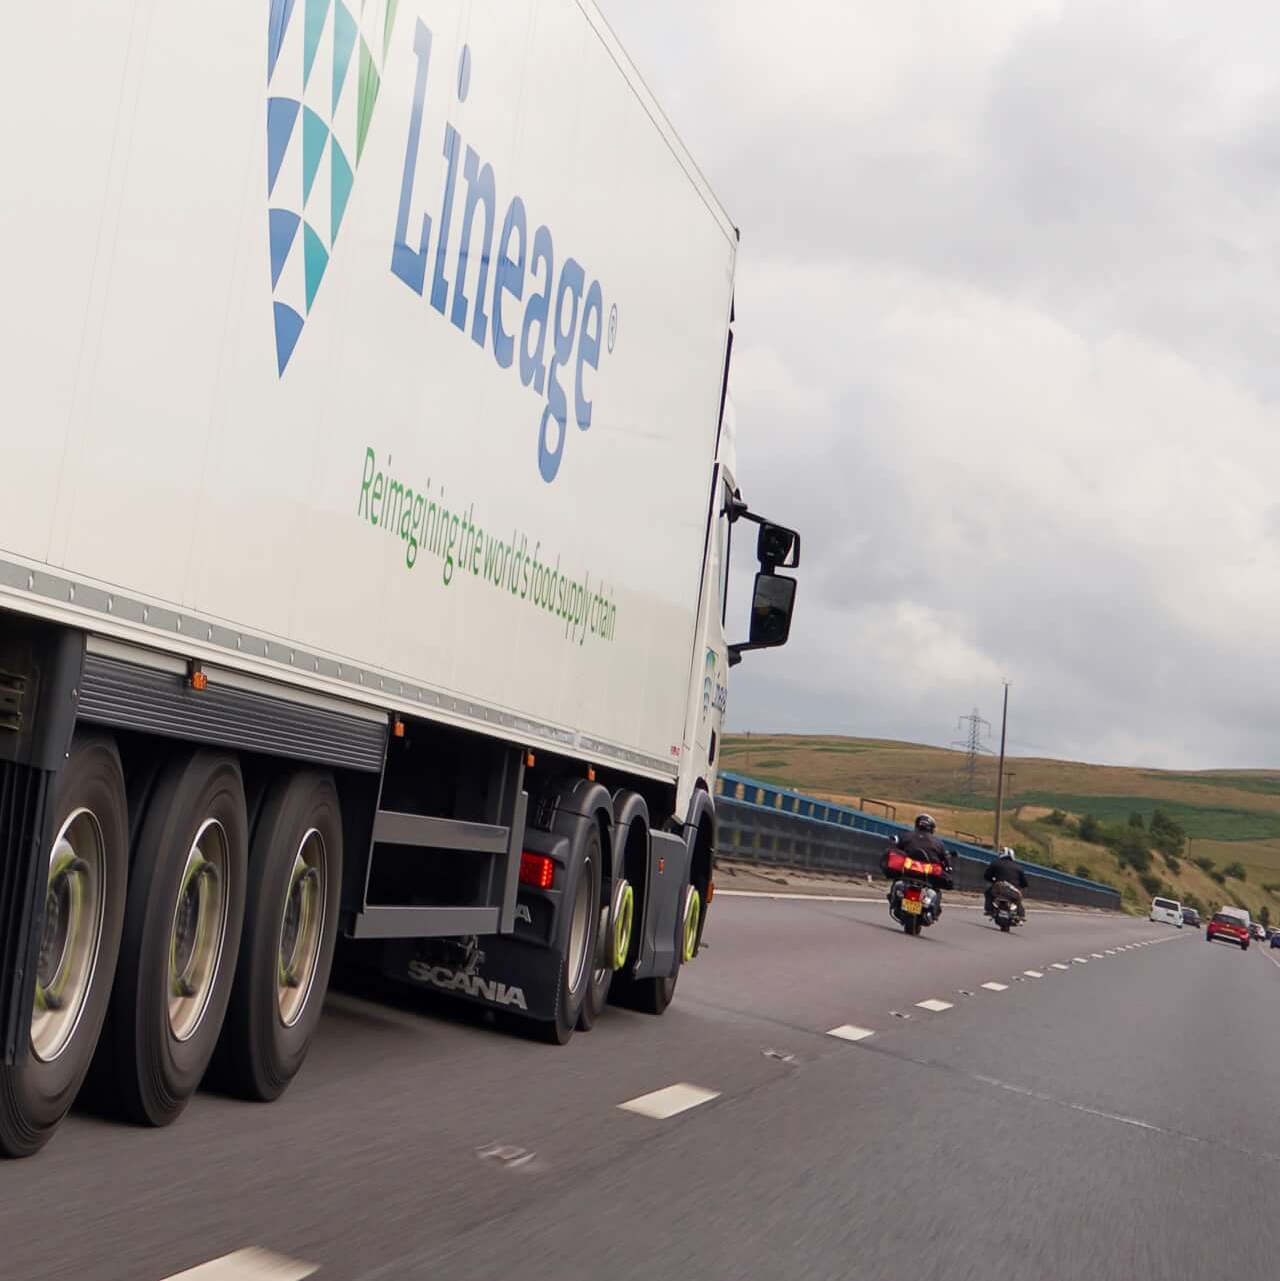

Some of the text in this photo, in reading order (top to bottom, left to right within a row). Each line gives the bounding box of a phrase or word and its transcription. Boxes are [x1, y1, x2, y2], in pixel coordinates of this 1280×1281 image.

[358, 446, 617, 647] Reimagining the world's food supply chain
[407, 959, 528, 1010] SCANIA
